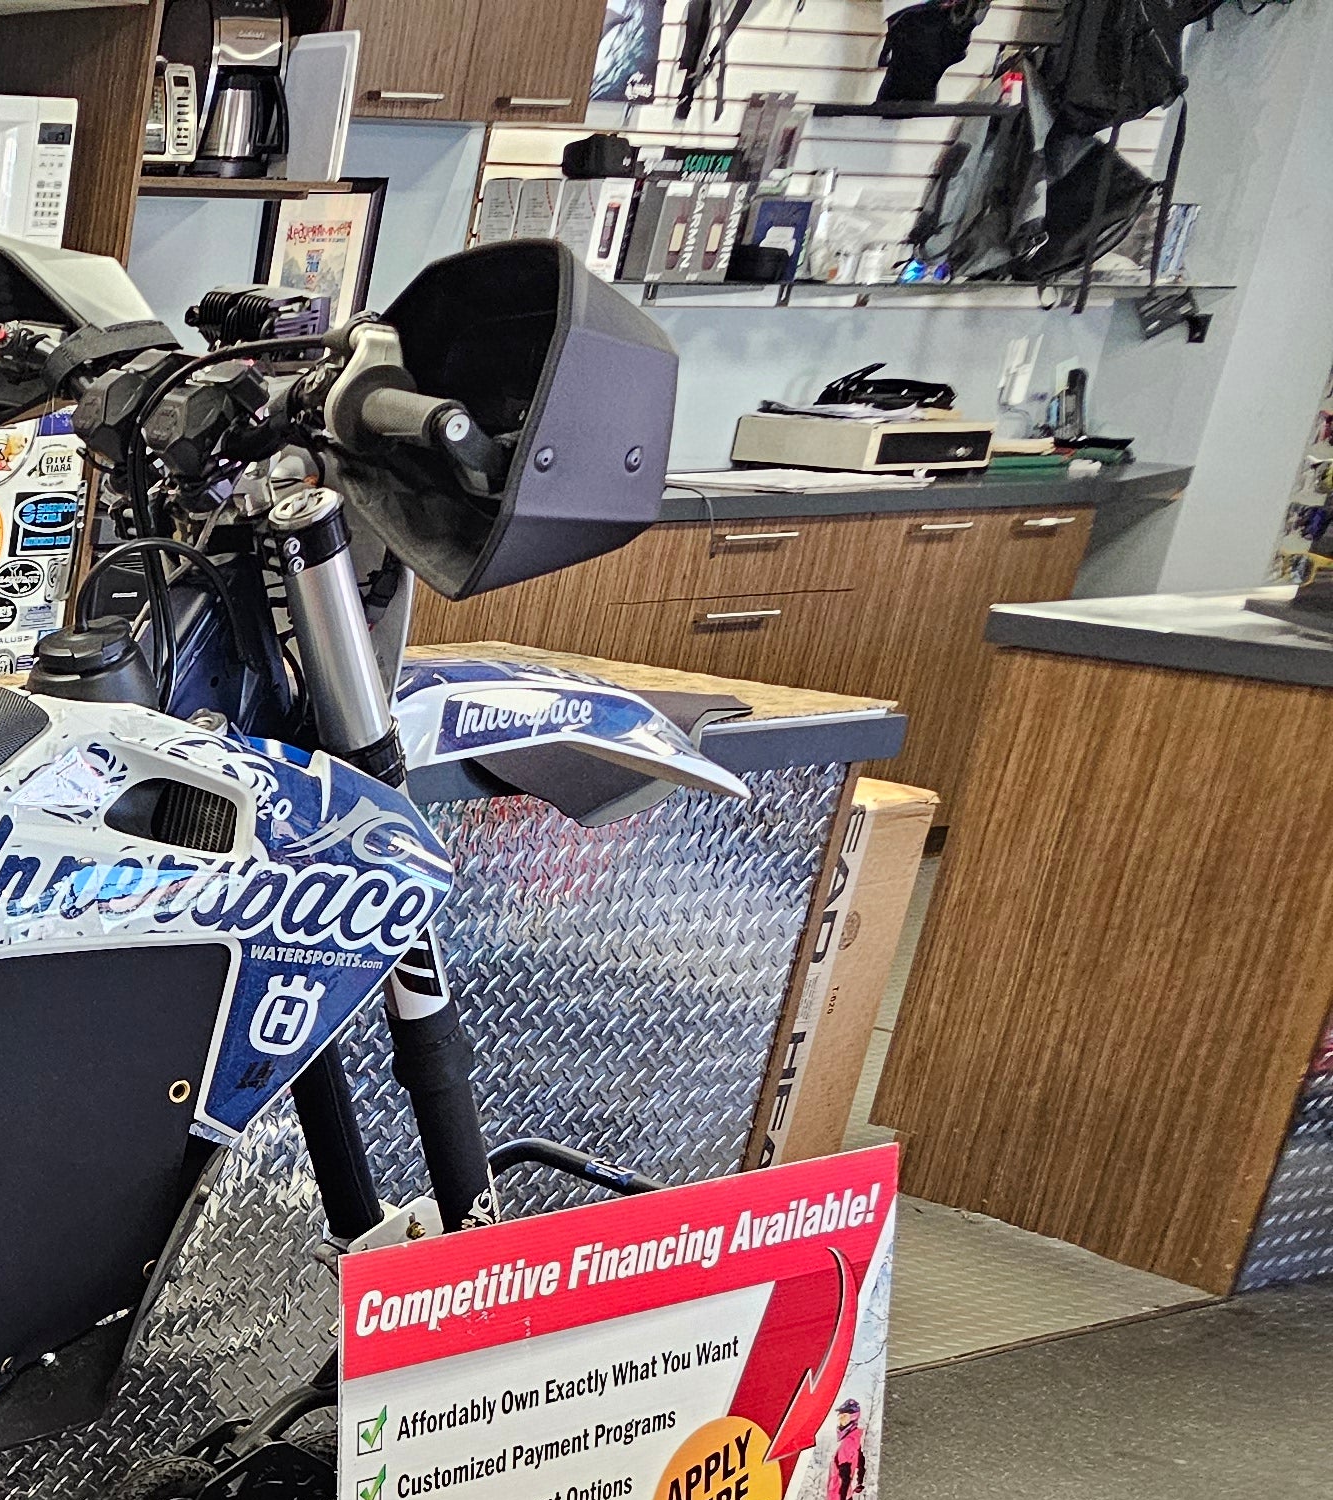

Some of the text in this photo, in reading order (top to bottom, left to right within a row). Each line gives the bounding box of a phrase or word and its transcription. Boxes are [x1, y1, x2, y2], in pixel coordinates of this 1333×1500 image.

[679, 184, 709, 271] GARMIN
[716, 182, 750, 271] GARMIN
[45, 455, 73, 465] DIVE
[45, 465, 72, 473] TIARA
[455, 698, 593, 739] Innerspace
[250, 944, 383, 970] WATERSPORTS.com
[355, 1182, 881, 1338] Competitive Financing Available!
[396, 1335, 739, 1441] Affordably Own Exactly What You Want
[396, 1409, 676, 1499] Customized Payment Programs
